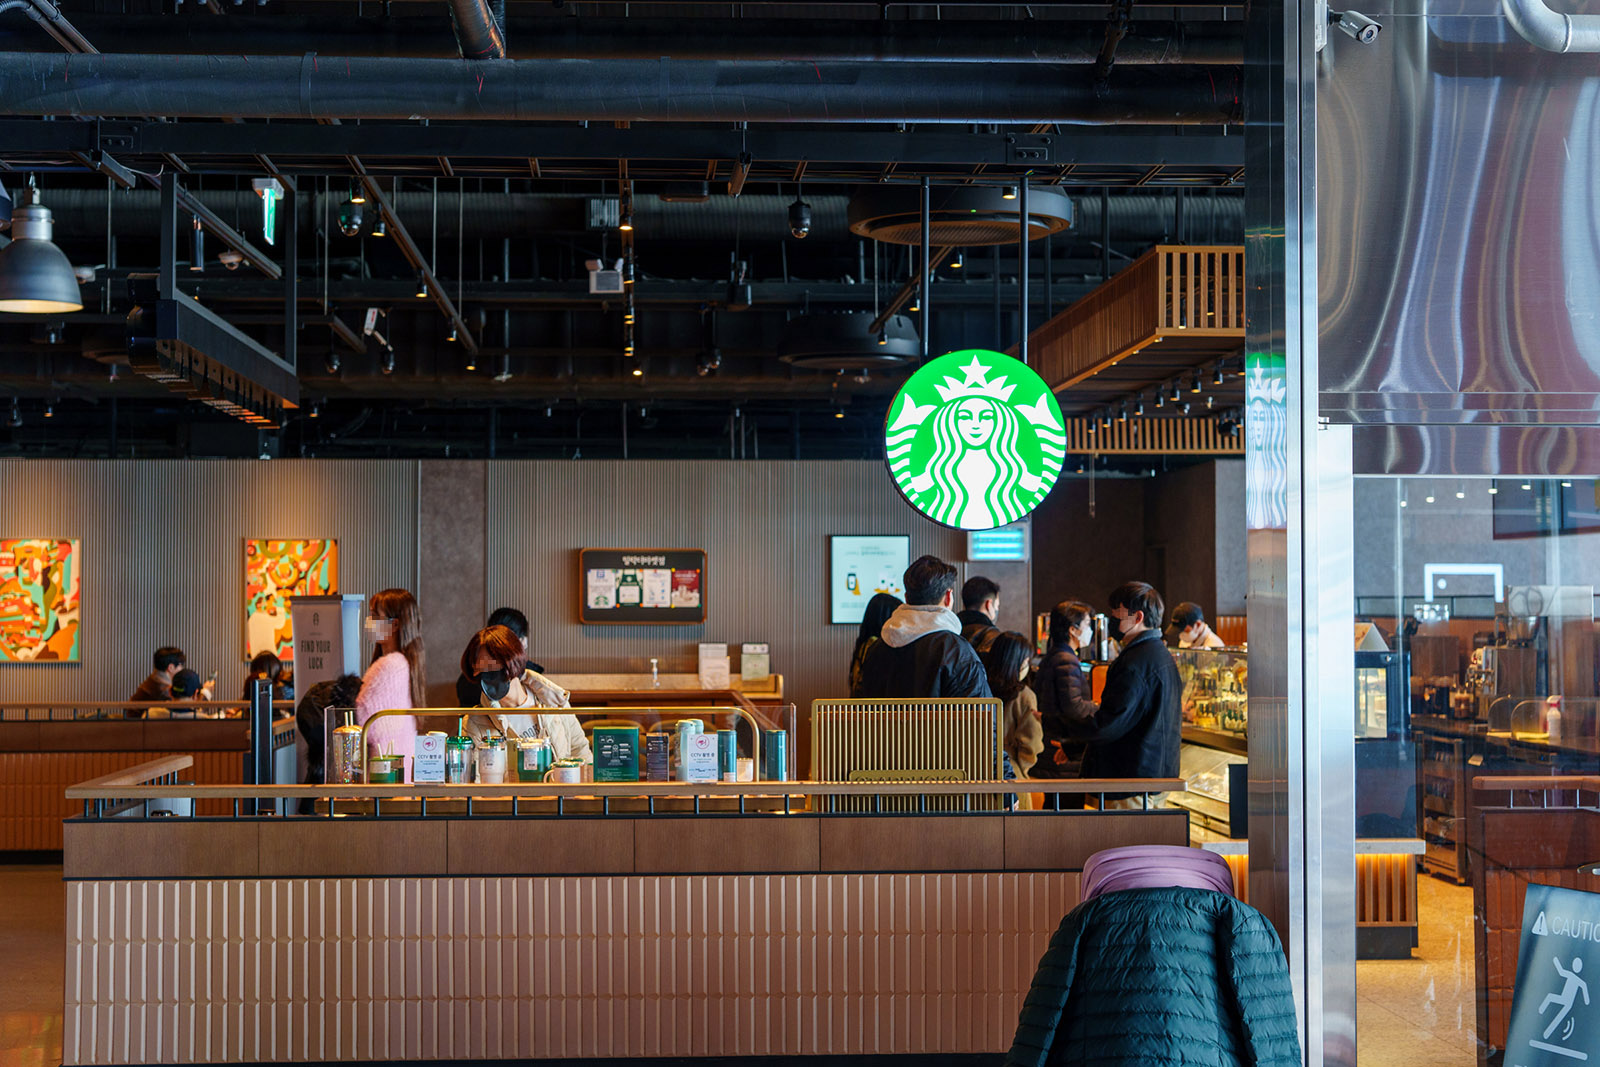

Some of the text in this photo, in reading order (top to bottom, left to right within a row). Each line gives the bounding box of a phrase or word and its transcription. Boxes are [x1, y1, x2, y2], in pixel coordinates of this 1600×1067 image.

[301, 640, 330, 652] FIND YOUR
[308, 656, 323, 669] LUCK
